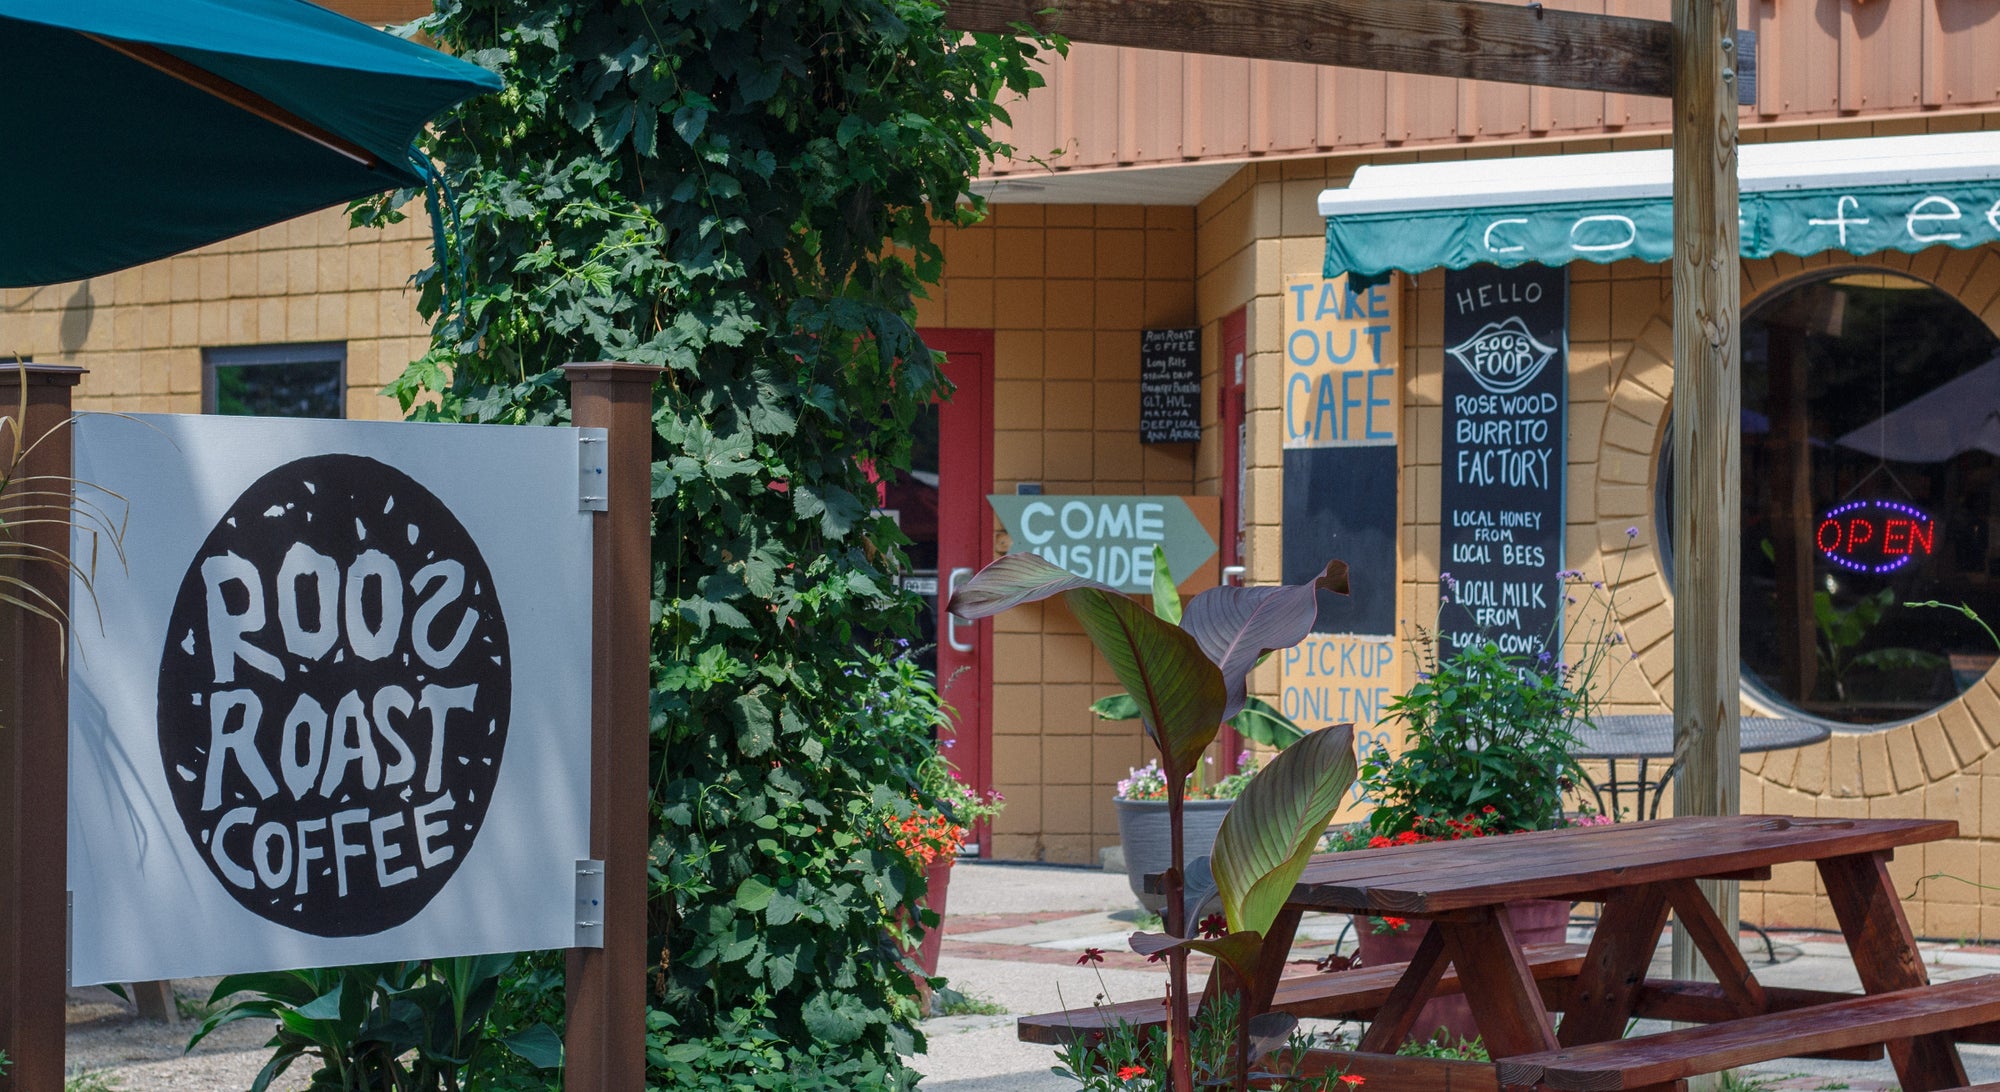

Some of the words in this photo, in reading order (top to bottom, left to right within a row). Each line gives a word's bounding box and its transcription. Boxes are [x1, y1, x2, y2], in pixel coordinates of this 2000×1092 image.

[1290, 283, 1391, 322] TAKE
[1456, 282, 1542, 315] HELLO
[1142, 341, 1196, 353] COFFEE
[1288, 325, 1391, 367] OUT
[1475, 335, 1530, 354] ROOS
[1475, 351, 1534, 377] FOOD
[1144, 409, 1189, 417] MATCHA
[1287, 368, 1394, 441] CAFE
[1455, 393, 1558, 416] ROSEWOOD
[1141, 419, 1173, 430] DEEP
[1147, 430, 1167, 443] ANN
[1457, 419, 1548, 445] BURRITO
[1458, 448, 1552, 490] FACTORY
[1020, 501, 1164, 545] COME
[1453, 510, 1496, 528] LOCAL
[1500, 510, 1542, 531] HONEY
[1475, 528, 1513, 543] FROM
[1817, 519, 1934, 554] OPEN
[1453, 543, 1492, 566] LOCAL
[1502, 544, 1545, 567] BEES
[1455, 580, 1499, 607] LOCAL
[1502, 581, 1547, 610] MILK
[201, 542, 479, 683] ROOS
[1476, 608, 1521, 631] FROM
[1499, 633, 1545, 654] COWS
[1285, 641, 1393, 678] PICKUP
[1283, 686, 1389, 724] ONLINE
[201, 684, 478, 810] ROAST
[211, 797, 456, 897] COFFEE
